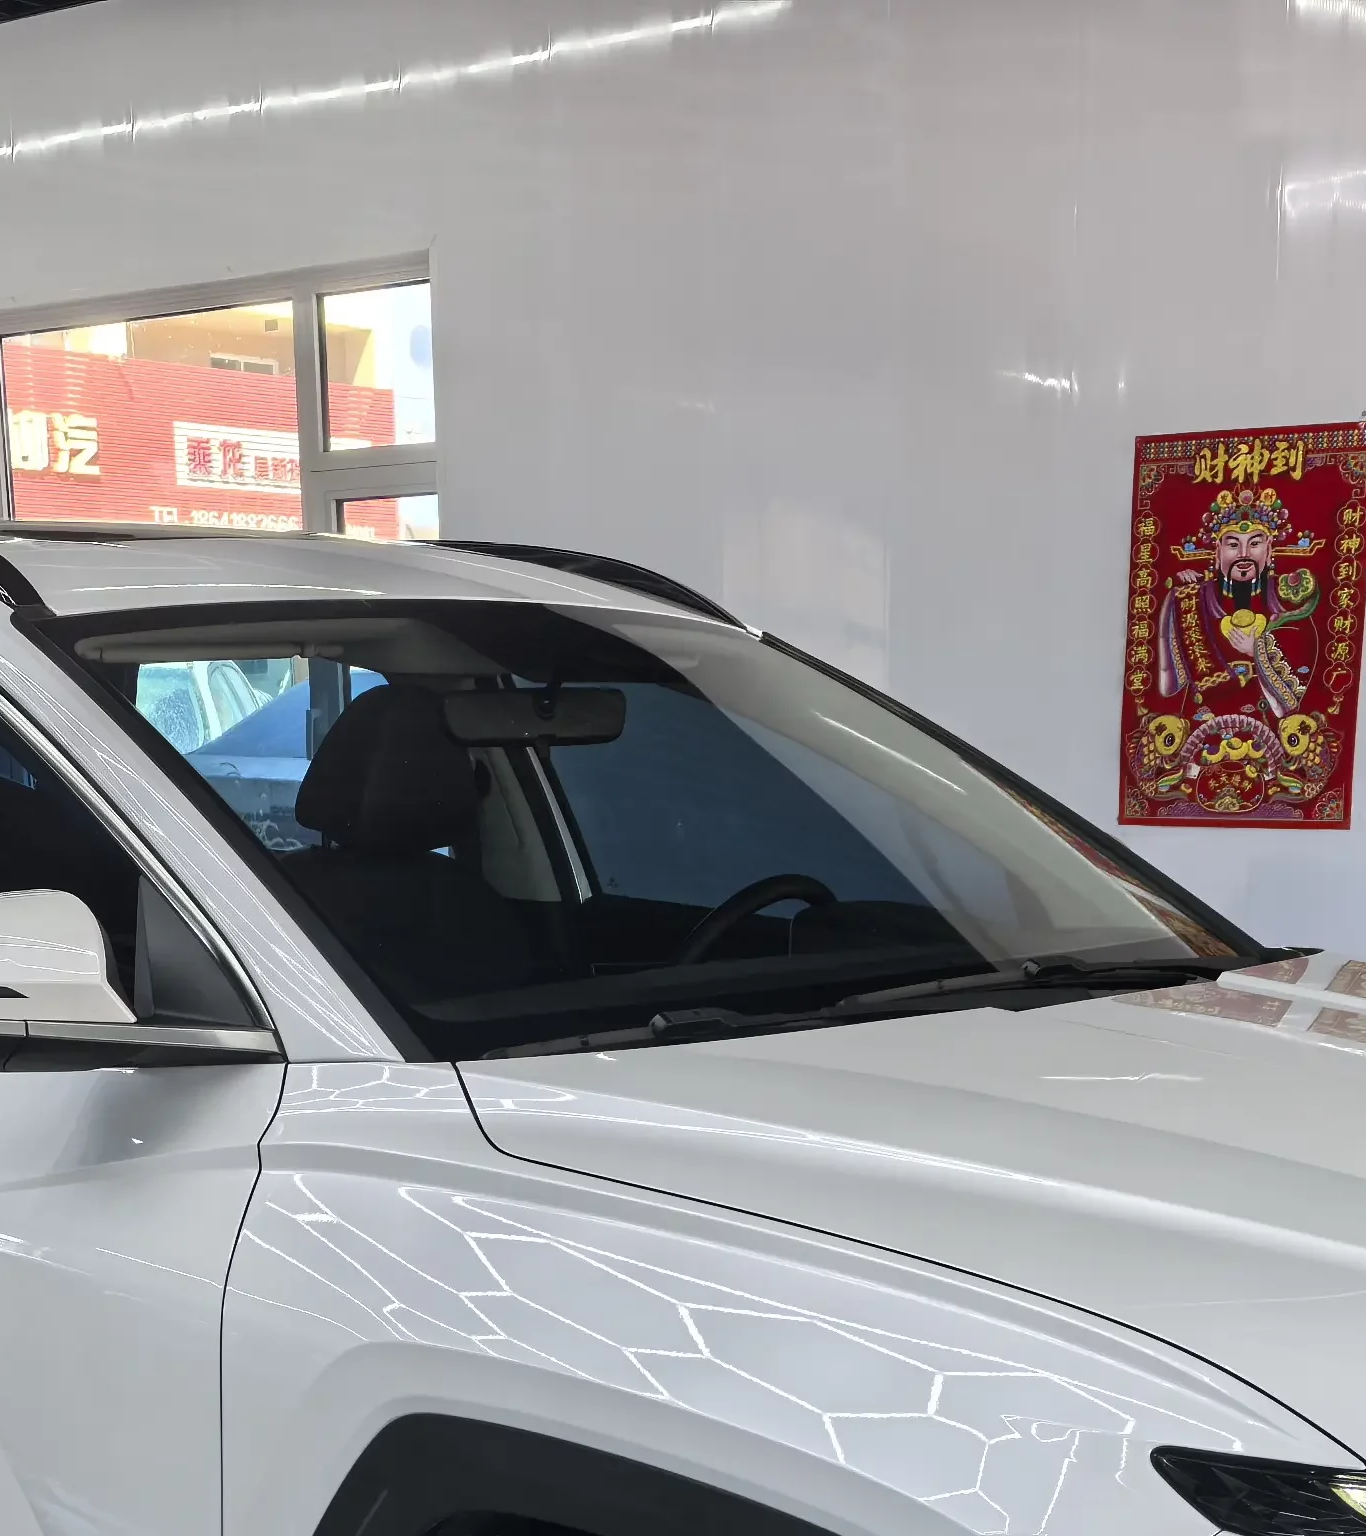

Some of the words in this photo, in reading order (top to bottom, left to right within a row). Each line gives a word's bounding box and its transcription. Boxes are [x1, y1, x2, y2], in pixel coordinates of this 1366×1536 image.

[1193, 438, 1305, 484] 财神到
[1129, 517, 1156, 690] 福星高照福满堂
[1330, 508, 1364, 686] 财神到家财源广
